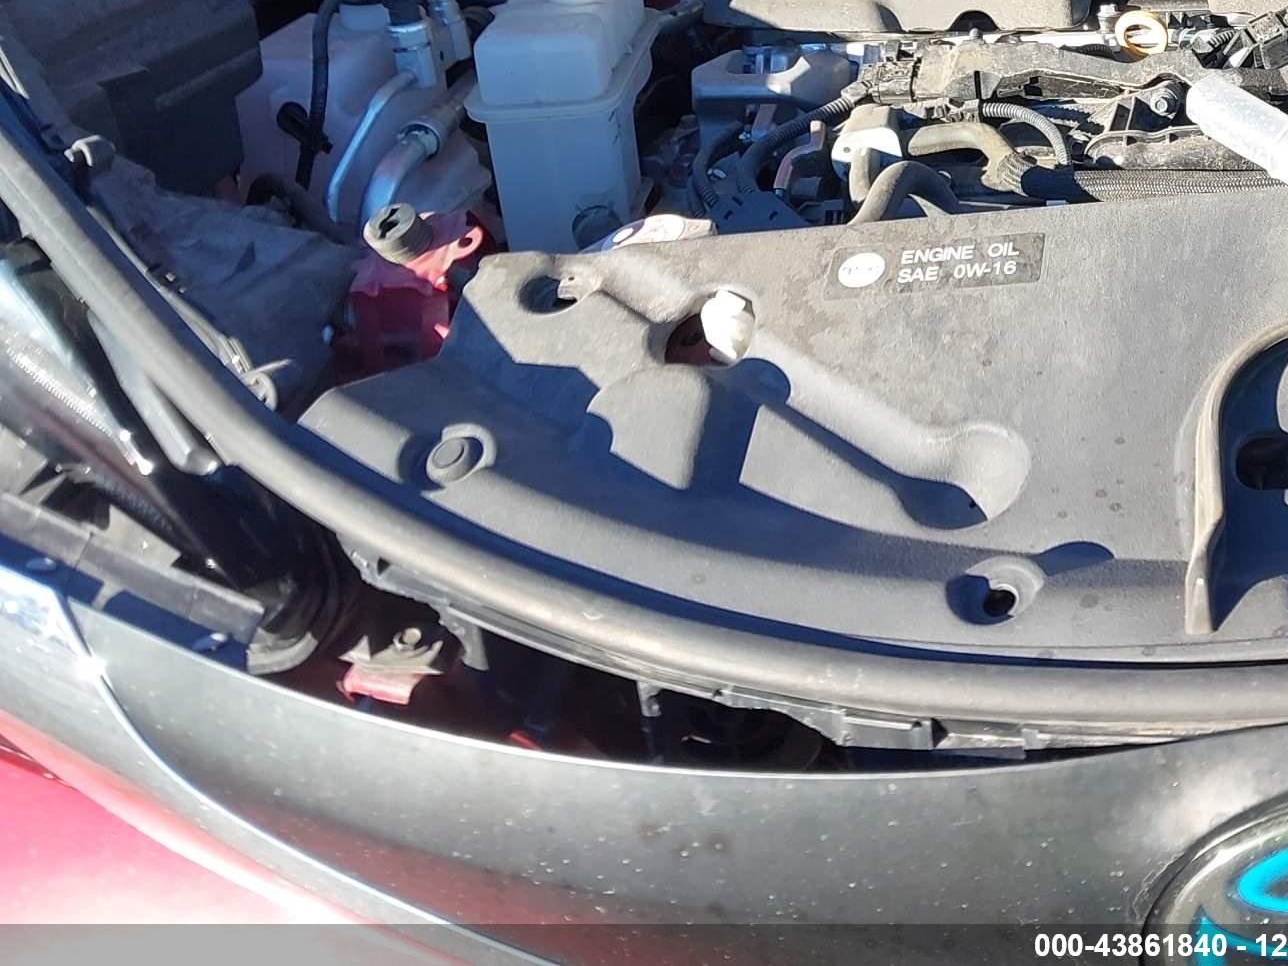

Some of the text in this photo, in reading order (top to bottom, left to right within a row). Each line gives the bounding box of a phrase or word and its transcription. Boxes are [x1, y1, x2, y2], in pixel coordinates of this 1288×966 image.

[900, 241, 1020, 265] ENGINE OIL
[897, 265, 940, 284] SAE
[953, 260, 1018, 279] 0W-16
